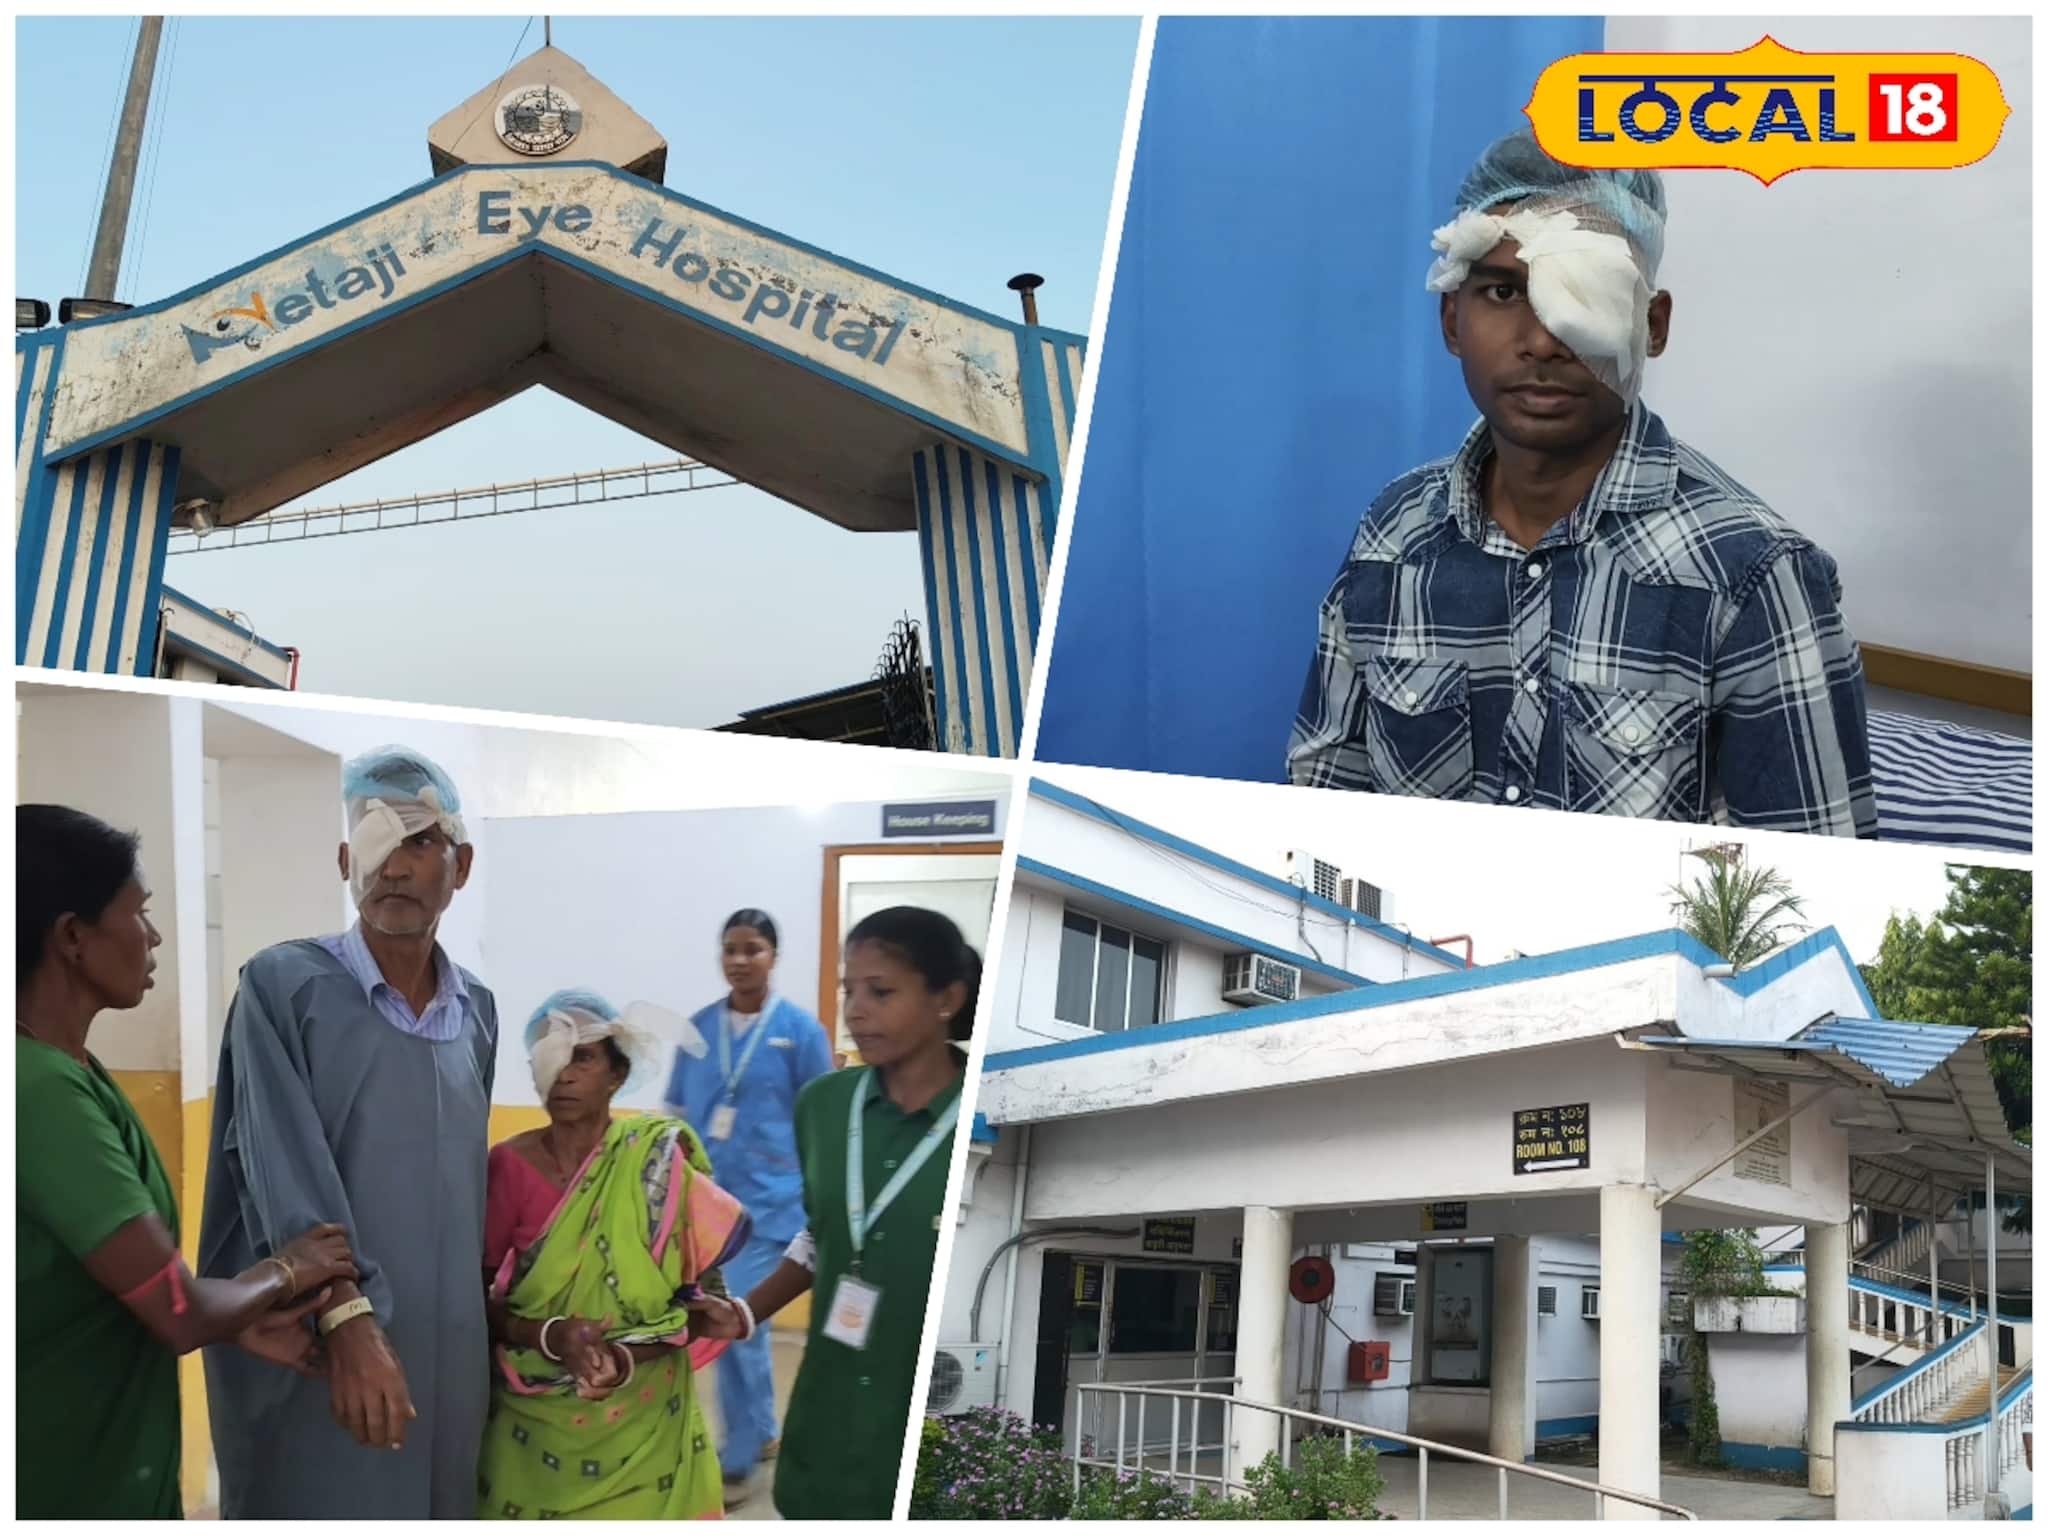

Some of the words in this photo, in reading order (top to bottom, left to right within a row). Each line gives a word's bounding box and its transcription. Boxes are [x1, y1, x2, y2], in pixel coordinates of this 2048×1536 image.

[476, 189, 593, 242] Eye
[628, 217, 907, 366] Hospital
[933, 812, 990, 828] Keeping
[1516, 1142, 1546, 1159] ROOM
